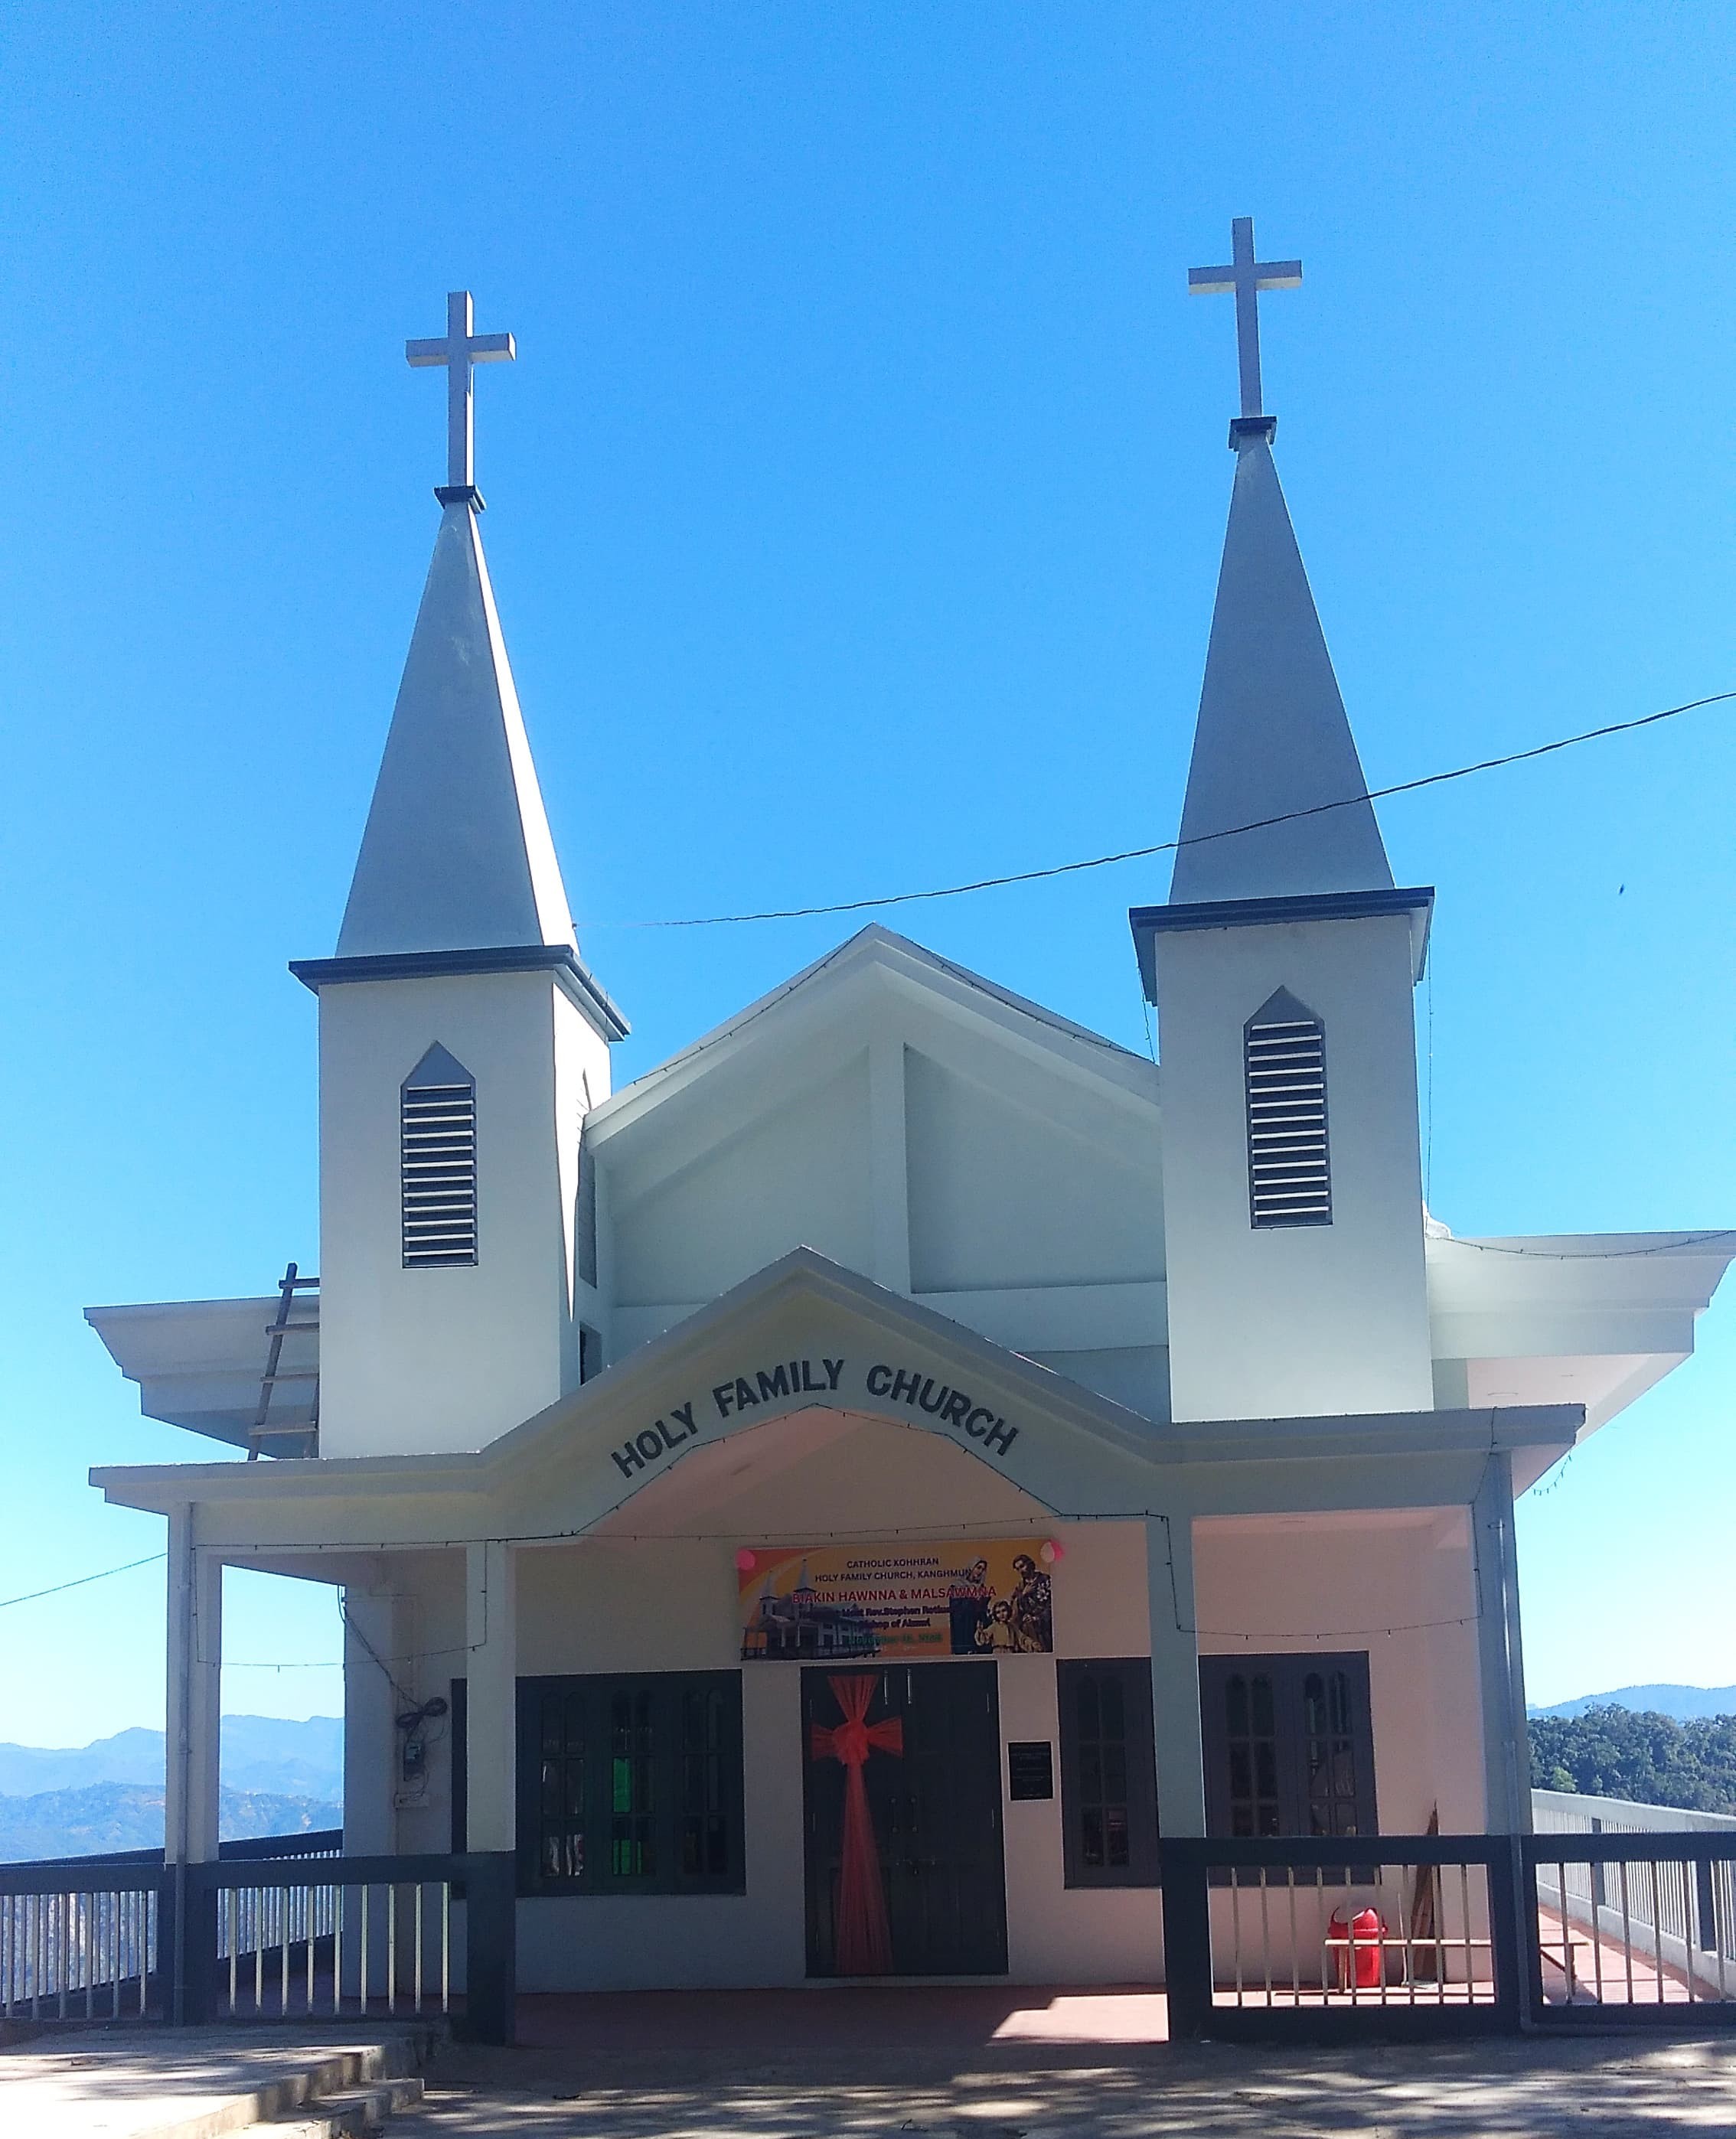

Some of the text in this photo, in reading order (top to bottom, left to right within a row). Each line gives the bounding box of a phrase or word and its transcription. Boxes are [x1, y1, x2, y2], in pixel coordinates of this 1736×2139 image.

[611, 1359, 1019, 1479] HOLY FAMILY CHURCH
[847, 1557, 939, 1568] CATHOLIC KOHHRAN
[815, 1573, 839, 1583] HOLY
[840, 1572, 873, 1581] FAMILY
[874, 1570, 917, 1580] CHURCH,
[792, 1586, 997, 1603] BIAKIN HAWNNA & MALSAWMNA
[891, 1619, 901, 1629] of
